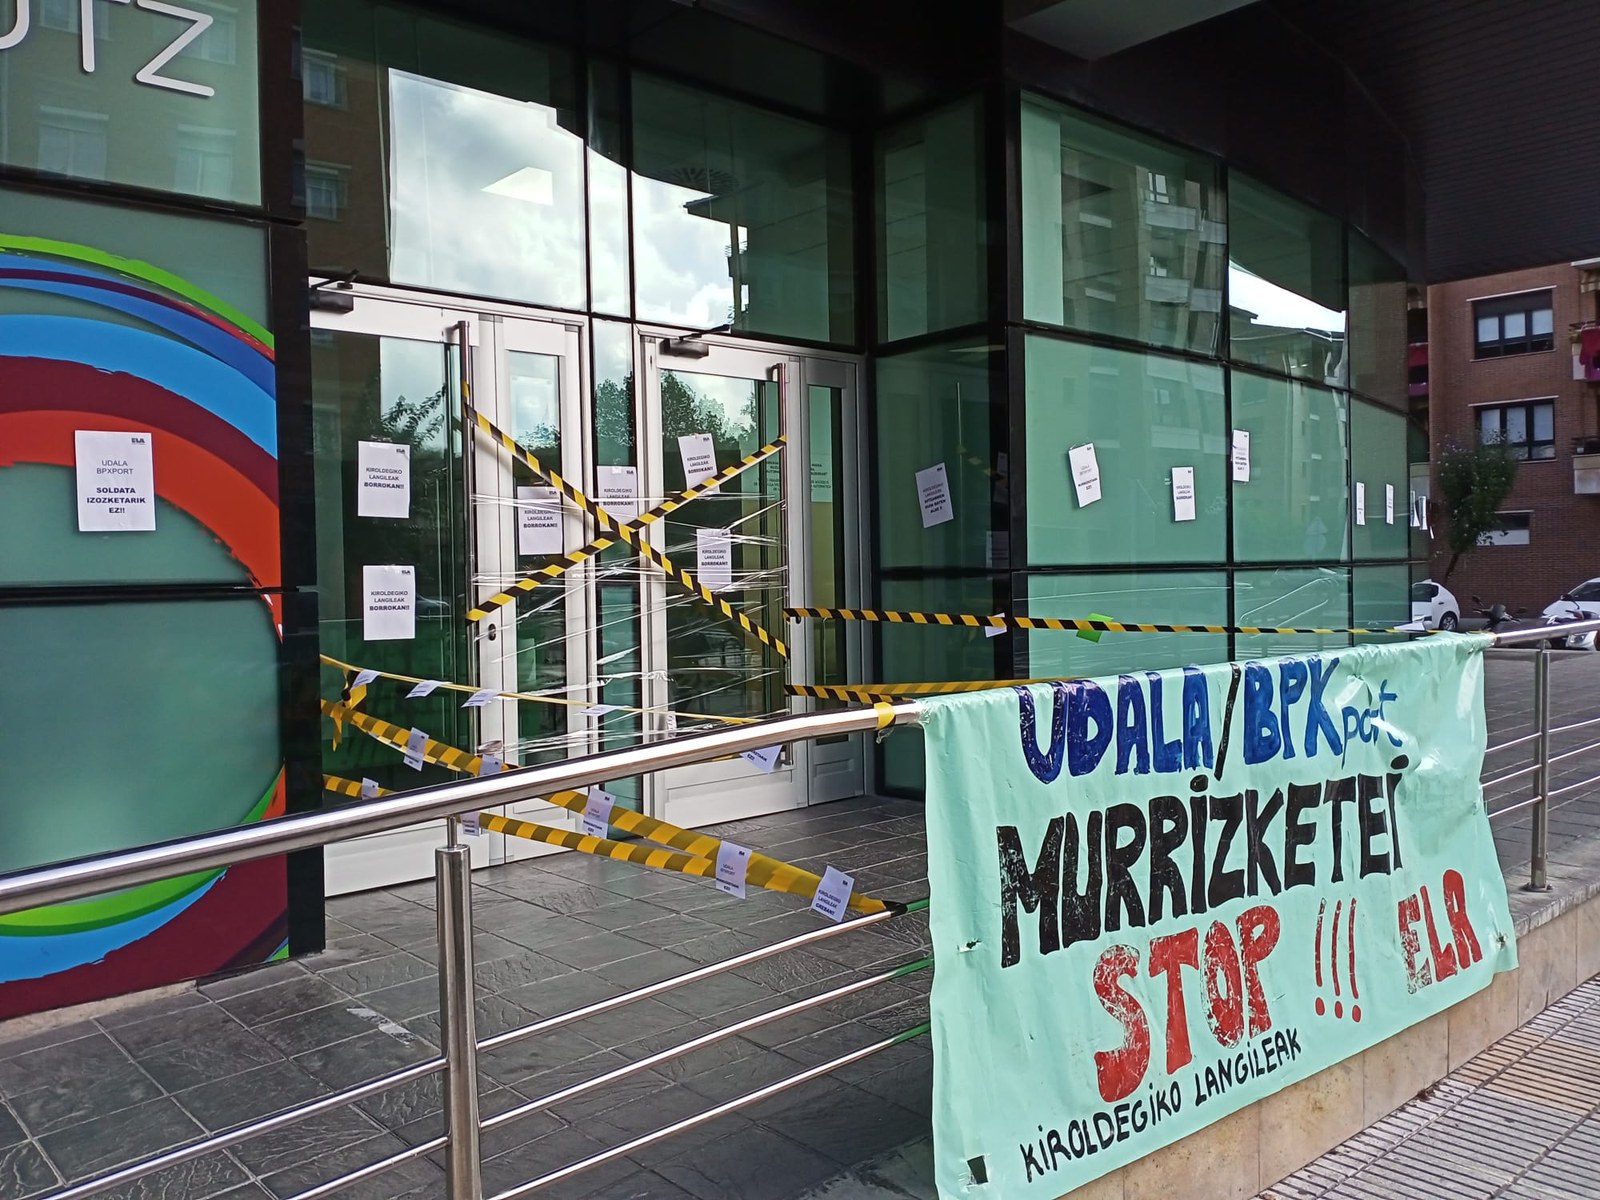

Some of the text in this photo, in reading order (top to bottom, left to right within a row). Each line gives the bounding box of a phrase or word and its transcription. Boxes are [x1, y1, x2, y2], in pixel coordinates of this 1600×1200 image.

[96, 467, 134, 475] BPXPORT
[996, 754, 1410, 969] MURRIZKETEI
[1093, 905, 1281, 1103] STOP
[1019, 1027, 1302, 1184] KIROLDEGIKO LANGILEAK
